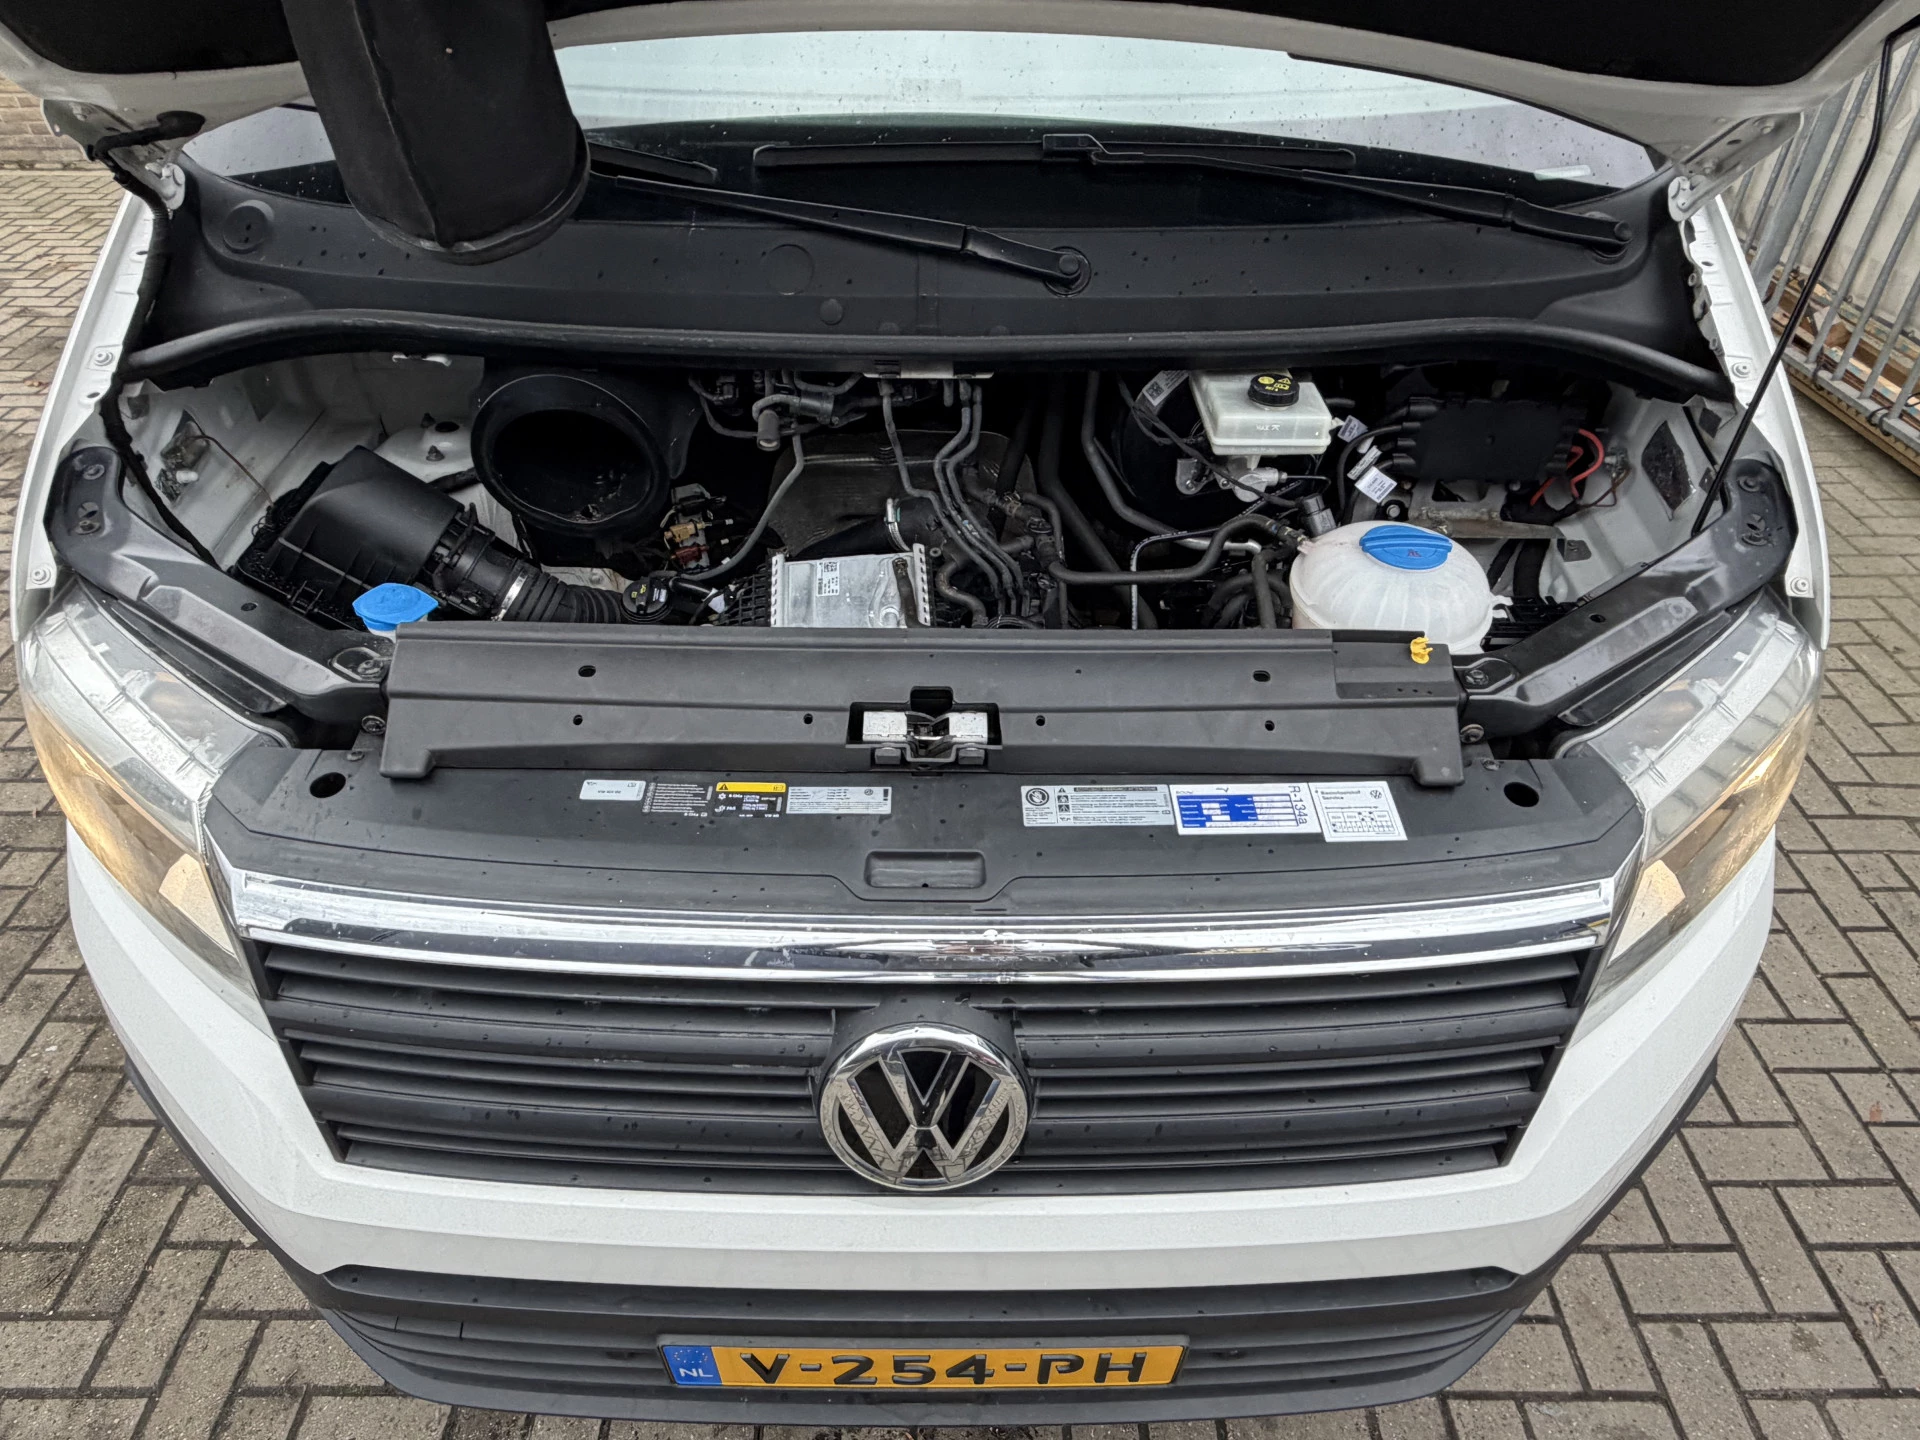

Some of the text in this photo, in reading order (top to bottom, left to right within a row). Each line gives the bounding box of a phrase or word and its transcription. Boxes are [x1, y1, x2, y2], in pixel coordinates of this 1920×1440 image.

[1288, 785, 1309, 825] R-134a
[679, 1367, 714, 1379] NL
[740, 1351, 1148, 1386] V-254-PH
